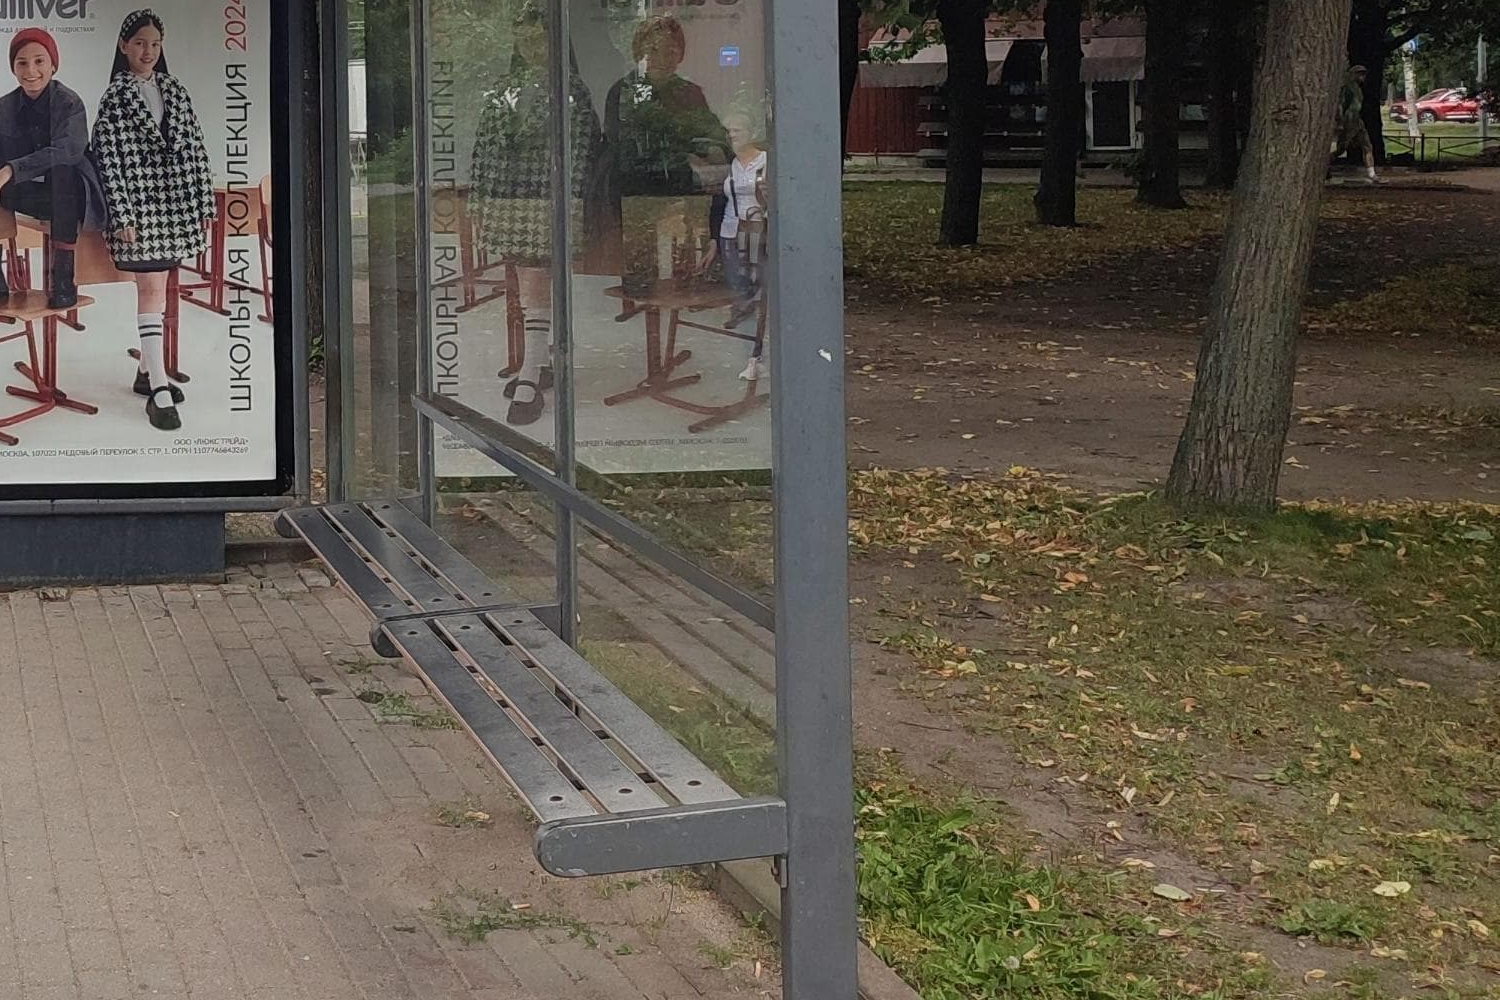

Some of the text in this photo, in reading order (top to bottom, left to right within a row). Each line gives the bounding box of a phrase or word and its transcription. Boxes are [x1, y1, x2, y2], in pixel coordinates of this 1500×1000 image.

[226, 62, 252, 238] КОЛЛЕКЦИЯ
[228, 249, 254, 413] ШКОЛЬНАЯ
[58, 448, 98, 457] МЕДОВЫЙ
